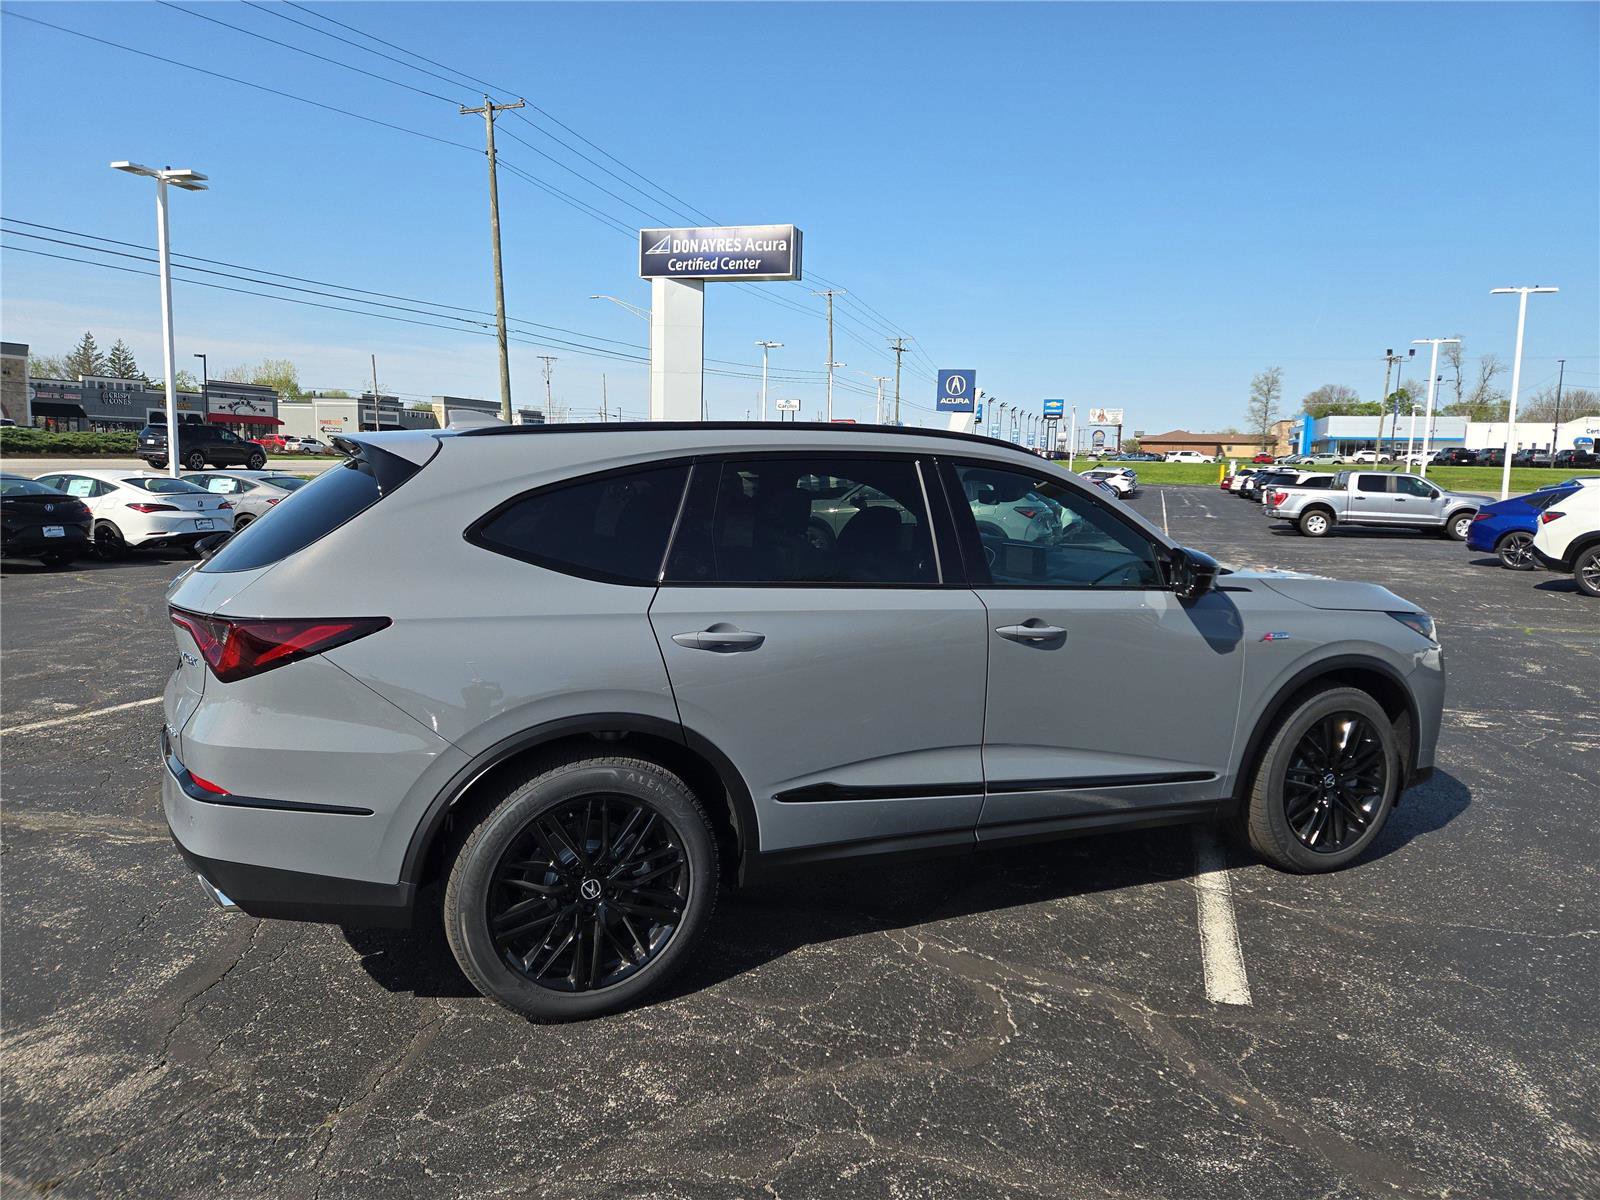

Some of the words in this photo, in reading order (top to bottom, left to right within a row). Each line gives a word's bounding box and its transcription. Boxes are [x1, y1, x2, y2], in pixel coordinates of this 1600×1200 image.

[673, 239, 699, 254] DON
[701, 238, 741, 253] AYRES
[744, 238, 787, 252] Acura
[668, 257, 719, 271] Certified
[720, 257, 762, 270] Center
[108, 391, 131, 399] CRISPY
